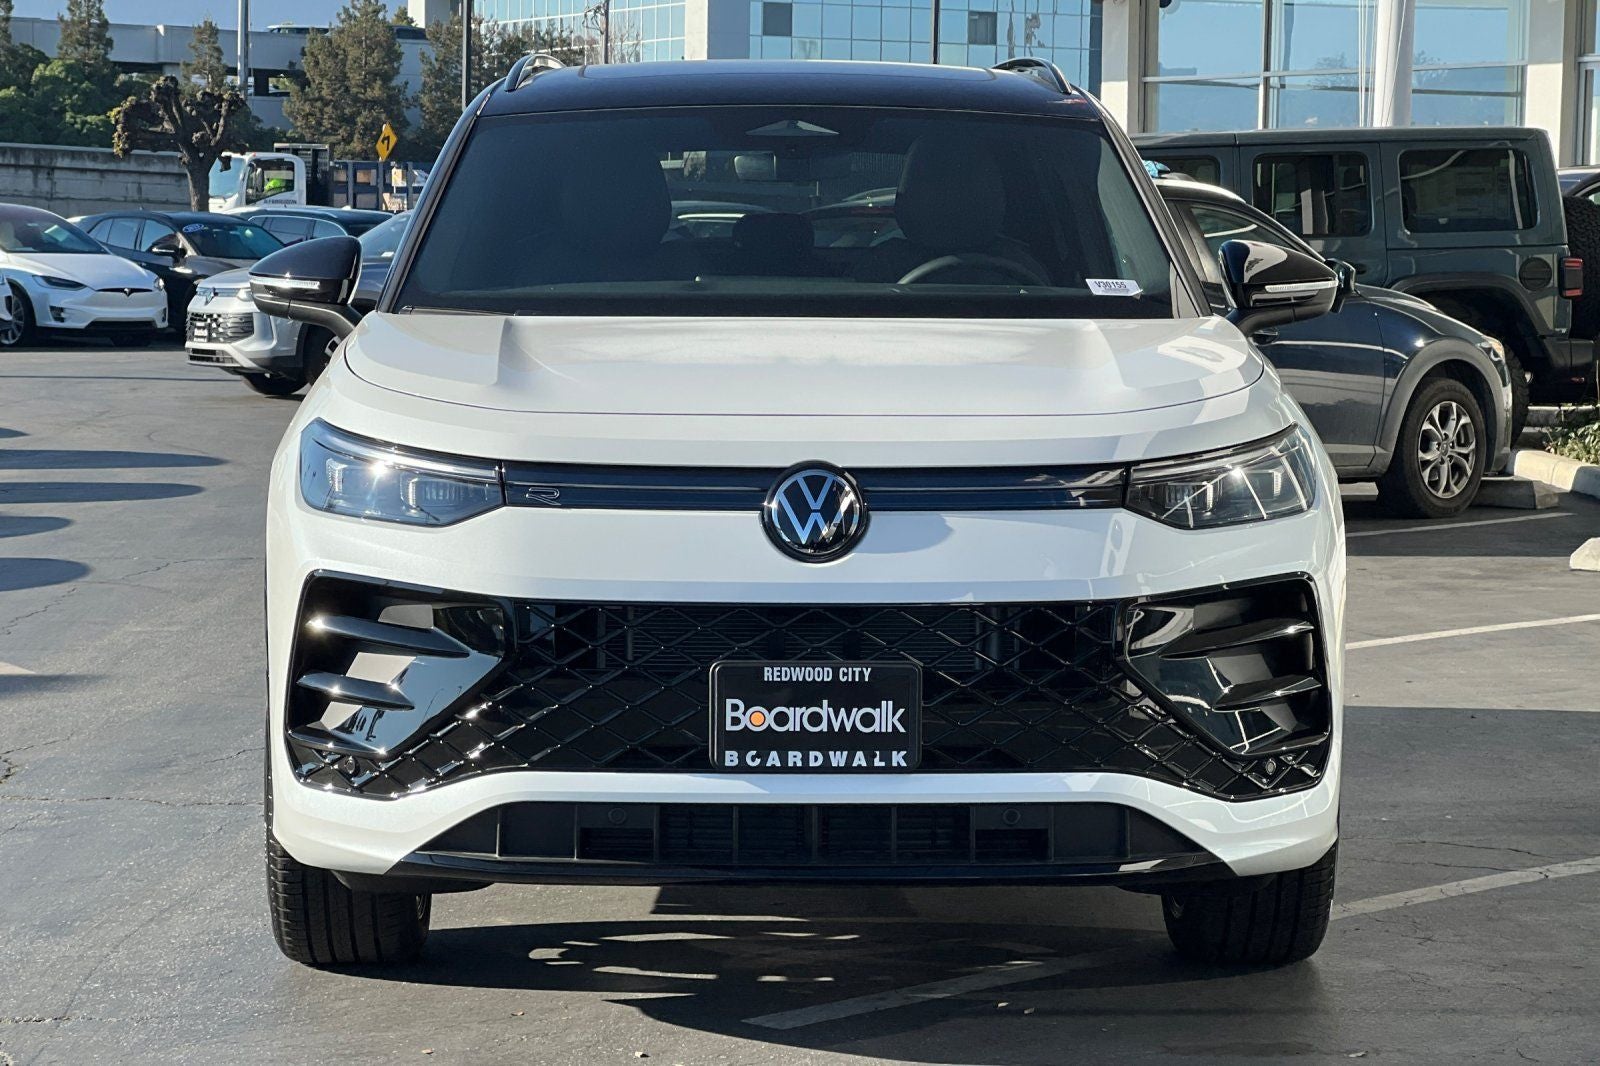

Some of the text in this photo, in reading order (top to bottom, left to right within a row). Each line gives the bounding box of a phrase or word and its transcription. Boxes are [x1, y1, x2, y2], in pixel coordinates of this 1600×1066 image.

[1094, 281, 1127, 289] V30155
[764, 667, 872, 682] REDWOOD CITY
[725, 698, 906, 733] Boardwalk
[724, 750, 908, 767] BOARDWALK
